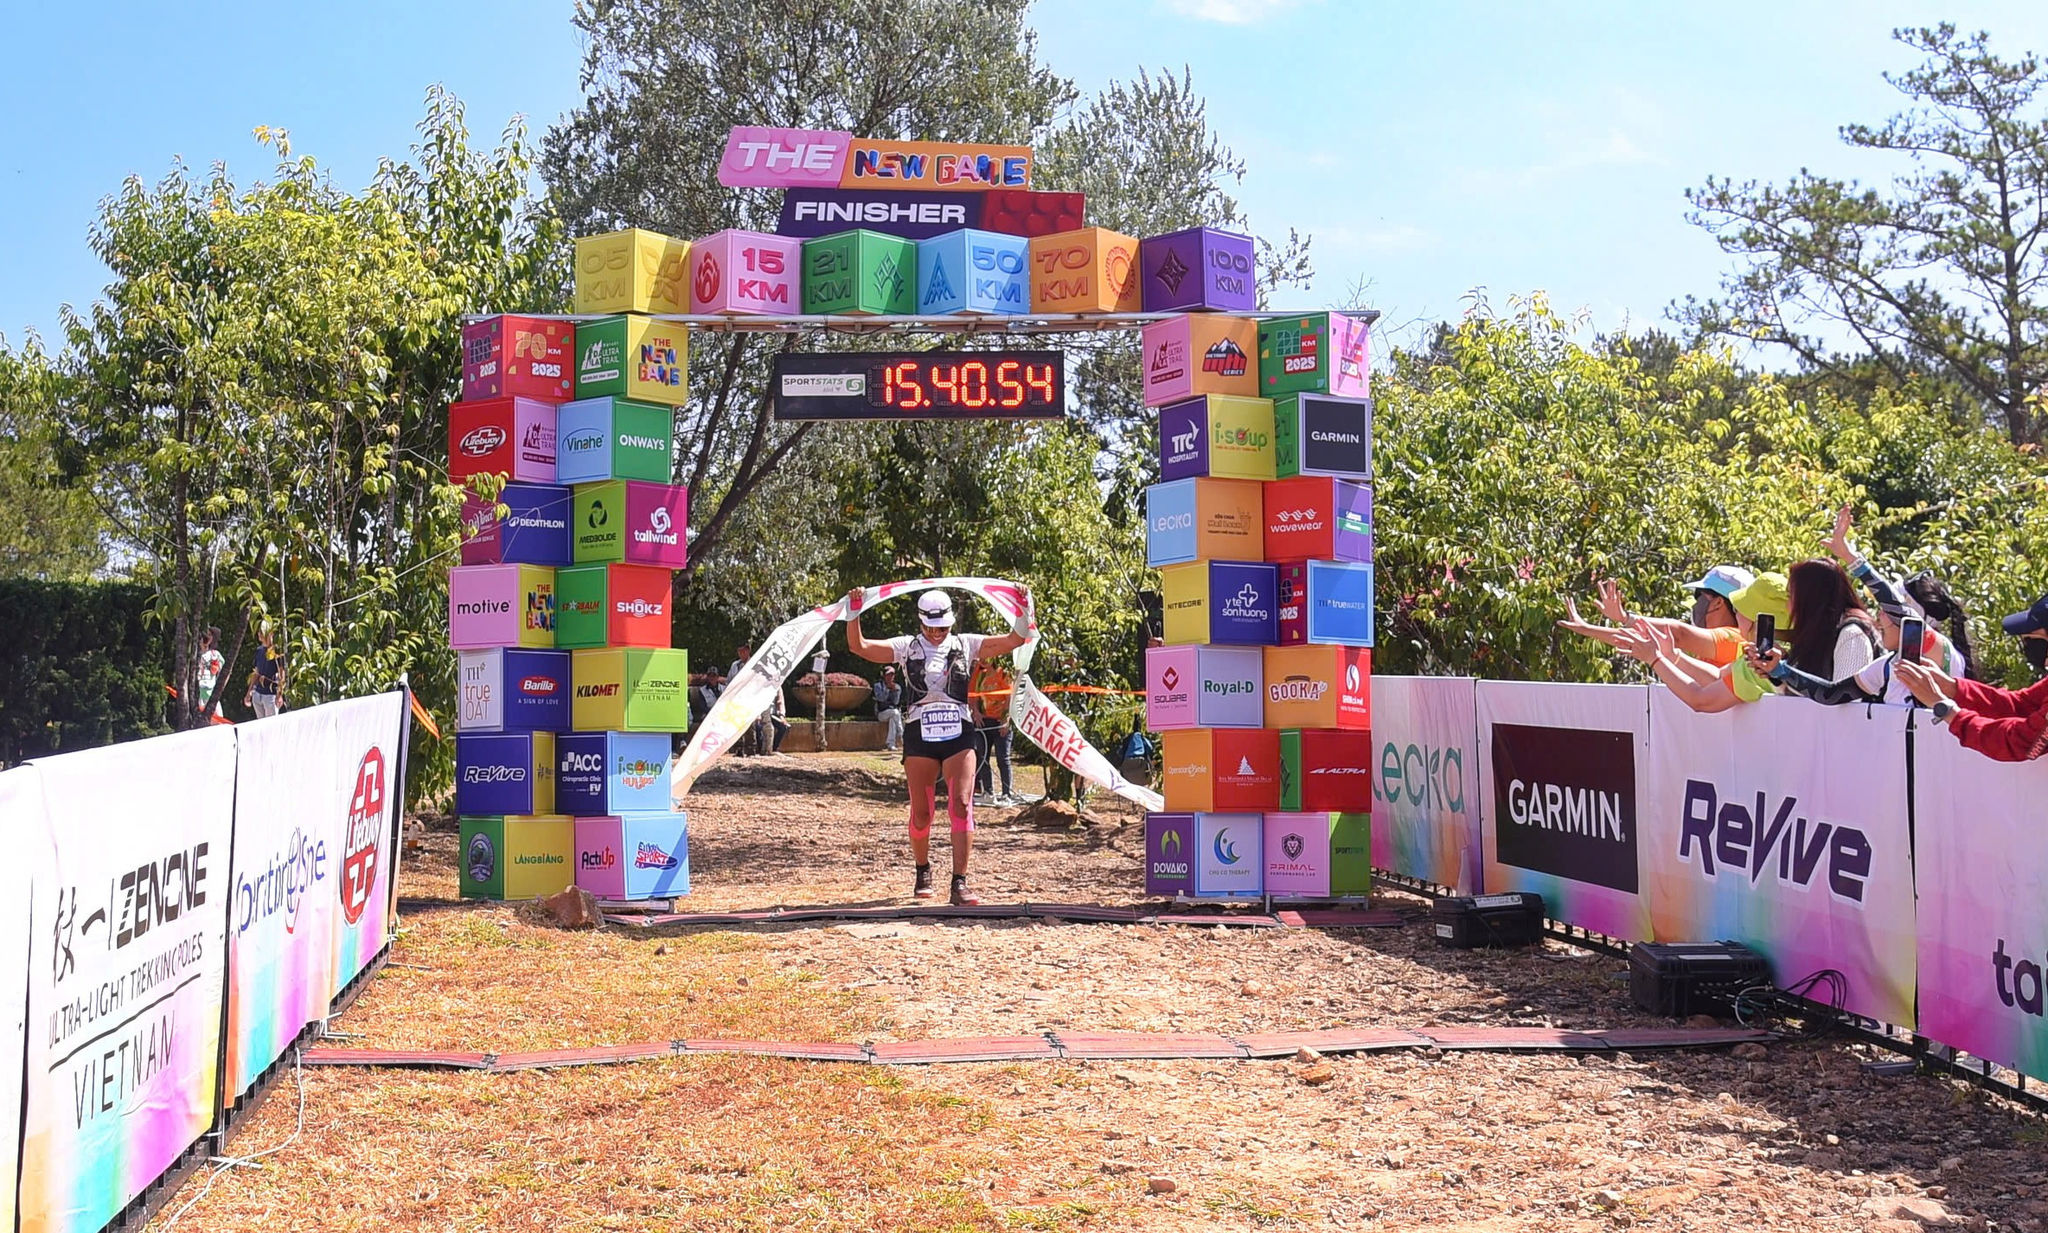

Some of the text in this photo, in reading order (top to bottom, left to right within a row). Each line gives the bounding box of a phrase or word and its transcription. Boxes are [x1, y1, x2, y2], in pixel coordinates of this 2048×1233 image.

[738, 141, 1028, 186] THE NEW GAME
[794, 201, 966, 224] FINISHER
[581, 247, 629, 274] 05
[742, 247, 785, 275] 15
[813, 246, 848, 276] 21
[972, 245, 1023, 274] 50
[1036, 246, 1090, 274] 70
[1209, 248, 1249, 274] 100
[584, 277, 626, 303] KM
[738, 277, 788, 304] KM
[809, 278, 850, 305] KM
[976, 278, 1021, 304] KM
[1040, 276, 1088, 302] KM
[1216, 274, 1245, 295] KM
[515, 330, 546, 360] 70
[653, 338, 671, 347] THE
[641, 344, 677, 364] NEW
[531, 362, 561, 378] 2025
[638, 363, 680, 386] GAME
[1285, 356, 1316, 373] 2025
[783, 377, 844, 387] SPORTSTATS
[567, 434, 603, 452] Vinahe
[620, 434, 665, 450] ONWAYS
[1172, 432, 1195, 454] TTC
[1311, 431, 1360, 444] GARMIN
[1168, 451, 1199, 464] HOSPITALITY
[520, 519, 564, 528] DECATHLON
[1270, 522, 1322, 533] wavewear
[634, 530, 678, 545] tailwind
[537, 584, 551, 592] THE
[457, 600, 510, 614] motive
[617, 602, 662, 615] SHOKZ
[1168, 599, 1202, 610] NITECORE
[465, 682, 491, 700] true
[524, 680, 554, 691] Barilla
[577, 684, 619, 698] KILOMET
[1204, 680, 1254, 696] Royal-D
[1270, 682, 1320, 702] GOOKA
[1155, 694, 1187, 703] SQUARE
[465, 699, 490, 721] OAT
[1021, 710, 1080, 769] GAME
[574, 754, 602, 773] ACC
[1508, 779, 1621, 843] GARMIN
[636, 851, 668, 864] SPORT
[1154, 863, 1188, 874] DOVAKO
[117, 842, 209, 949] ZENONE
[1993, 938, 2048, 1017] ta
[49, 976, 126, 1050] ULTRA-LIGHT
